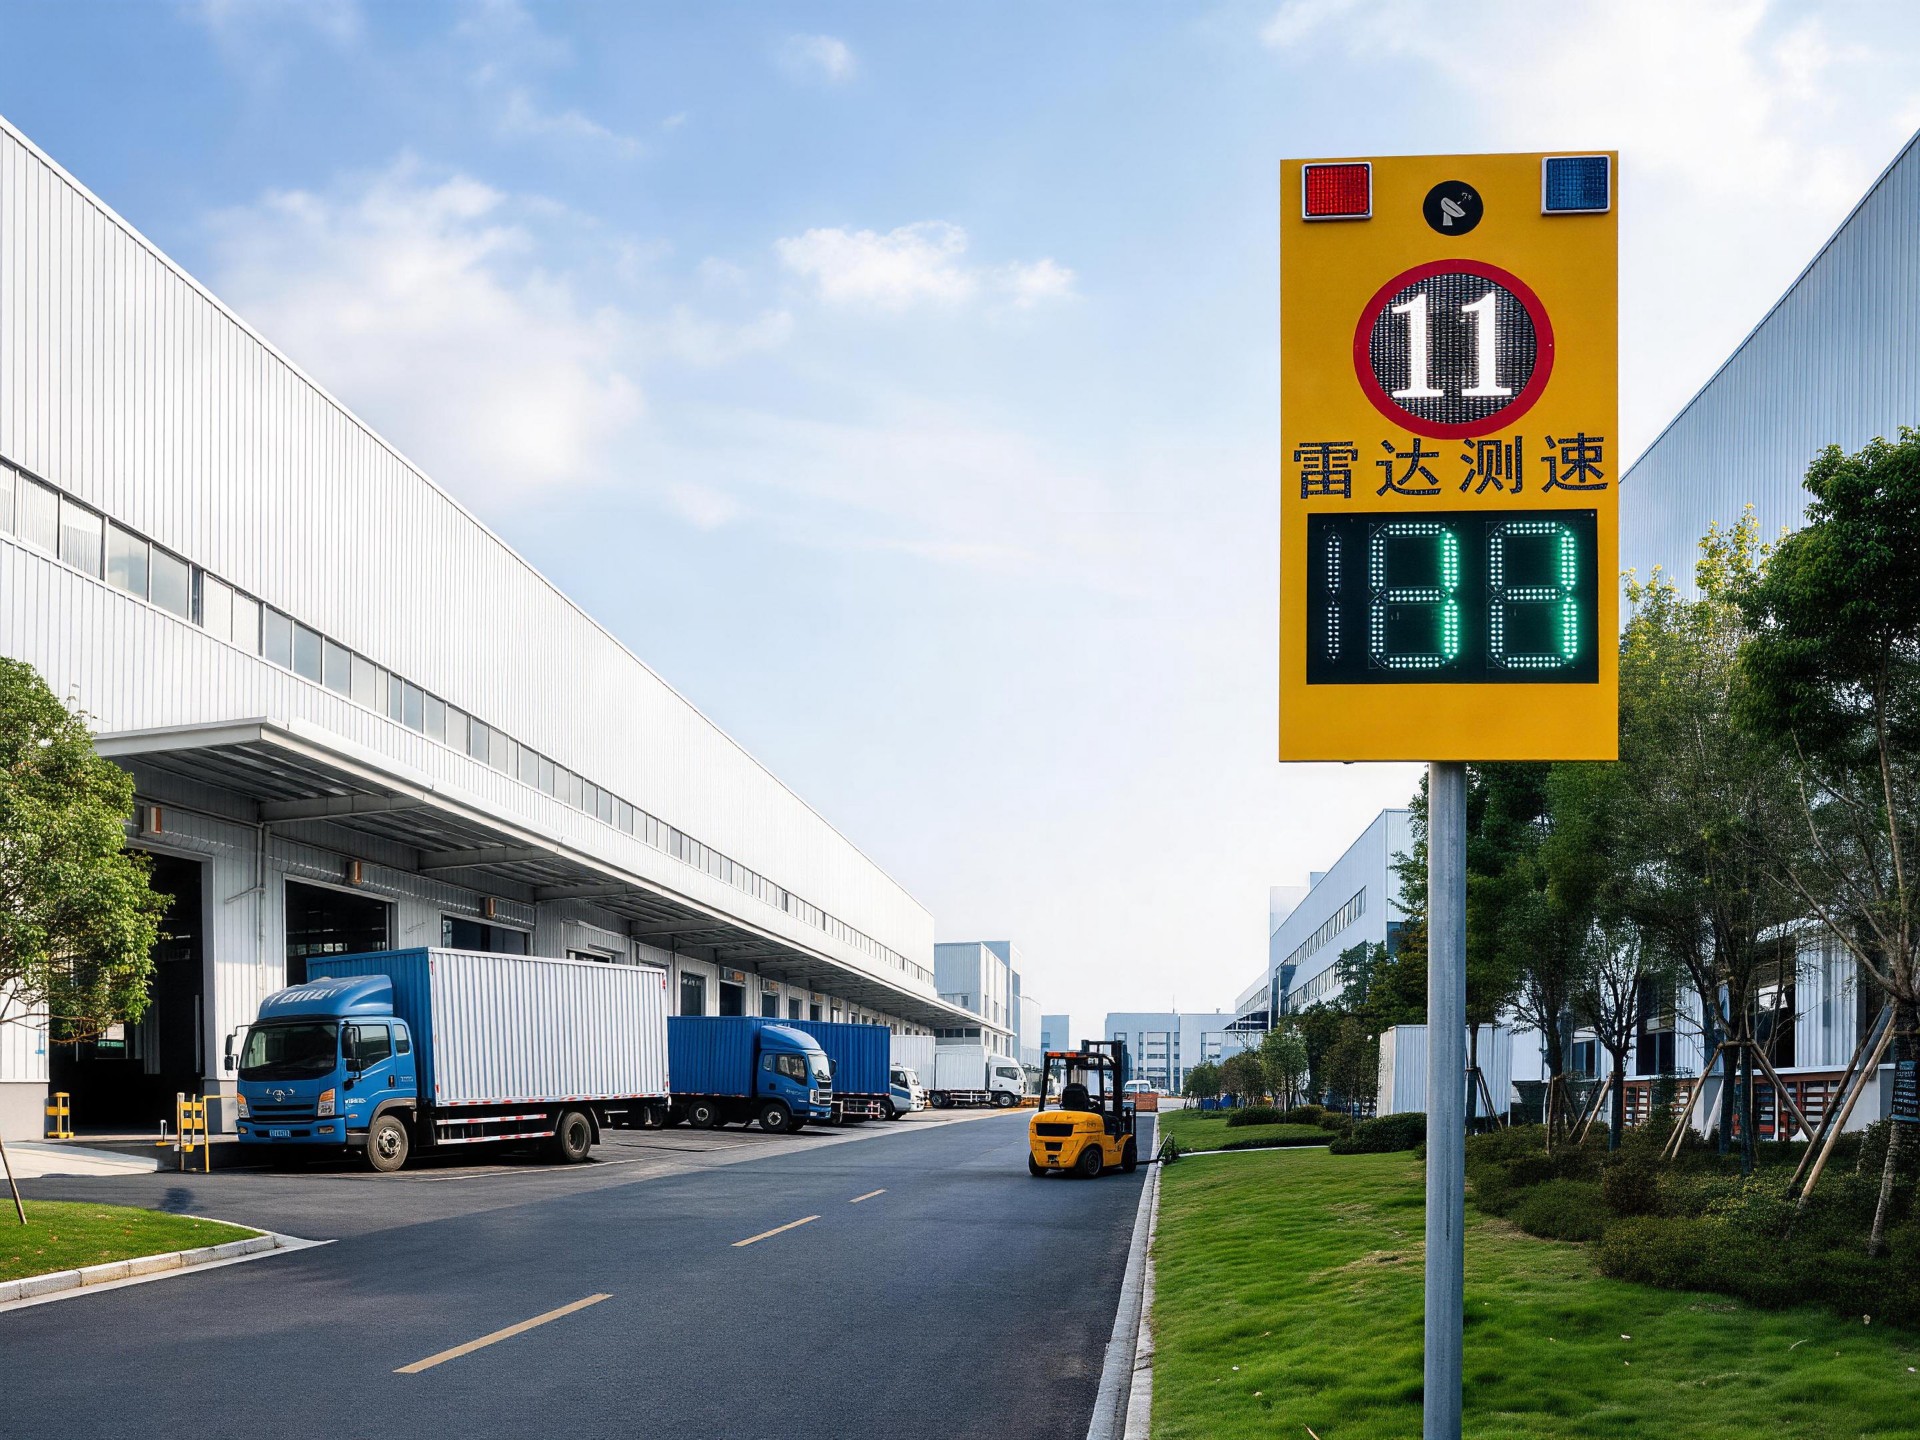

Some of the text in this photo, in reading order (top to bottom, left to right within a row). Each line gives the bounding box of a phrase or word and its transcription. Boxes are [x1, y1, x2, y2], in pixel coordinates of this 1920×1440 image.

[1392, 291, 1511, 397] 11
[1294, 433, 1608, 499] 雷达测速
